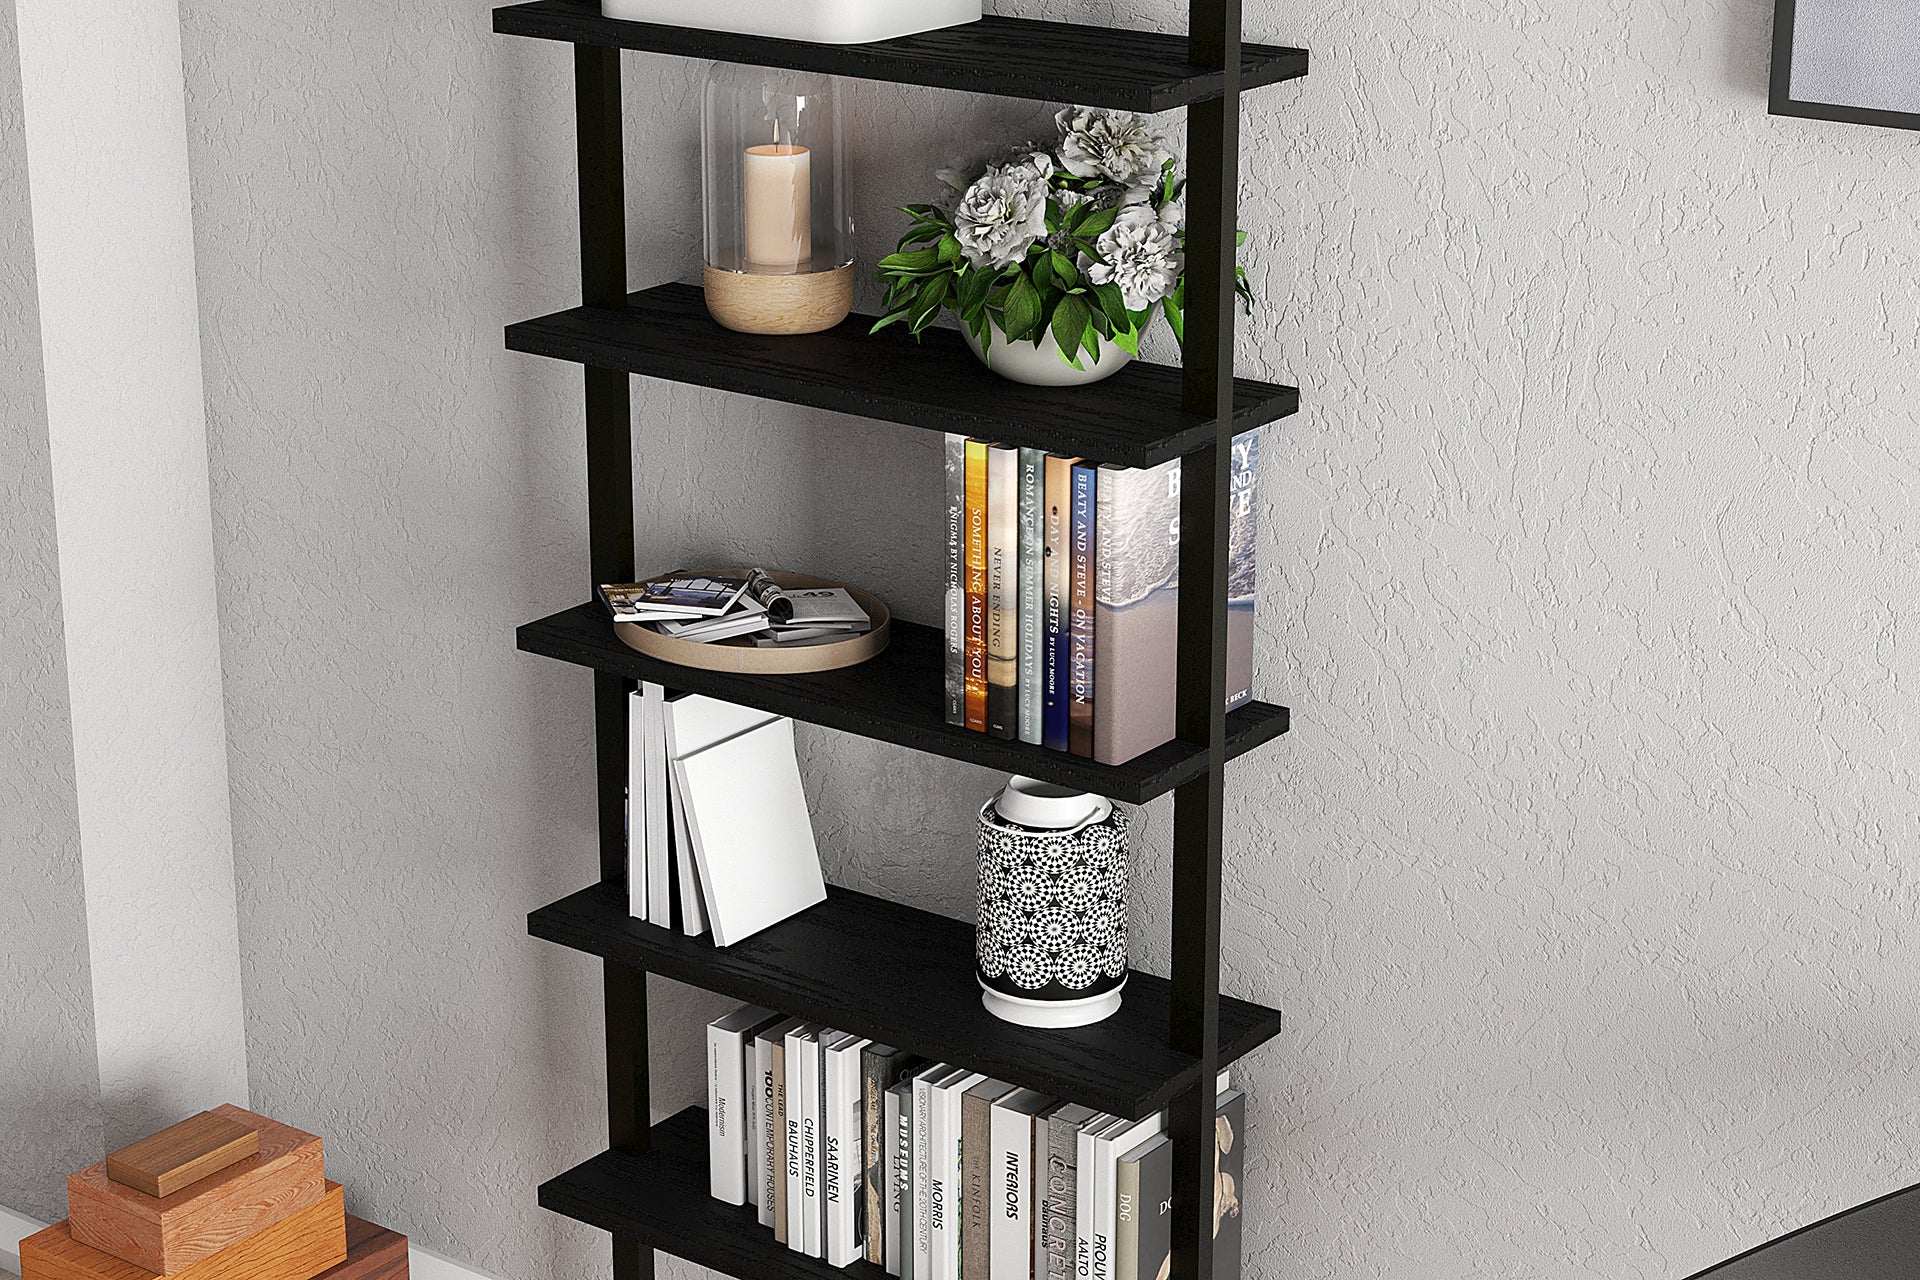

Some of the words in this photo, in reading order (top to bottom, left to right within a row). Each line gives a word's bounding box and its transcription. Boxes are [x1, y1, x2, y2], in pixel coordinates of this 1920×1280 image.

[1026, 464, 1034, 536] ROMANCE
[1078, 474, 1087, 518] BEATY
[1026, 536, 1034, 556] ON
[1050, 515, 1059, 544] DAY
[1077, 521, 1086, 551] AND
[1102, 526, 1112, 558] AND
[950, 549, 958, 558] BY
[972, 508, 982, 593] SOMETHING
[992, 547, 1002, 590] NEVER
[1050, 548, 1060, 578] AND
[1025, 558, 1034, 610] SUMMER
[1076, 555, 1086, 597] STEVE
[1102, 562, 1112, 603] STEVE
[972, 596, 982, 646] ABOUT
[992, 595, 1002, 648] ENDING
[1050, 582, 1059, 634] NIGHTS
[1076, 609, 1086, 629] ON
[1024, 614, 1034, 676] HOLIDAYS
[1049, 636, 1056, 646] BY
[972, 648, 982, 679] YOU
[1024, 676, 1032, 688] BY
[1076, 635, 1086, 704] VACATION
[1230, 689, 1248, 703] BECK
[918, 1088, 927, 1120] VISIONARY
[788, 1120, 798, 1178] BAUHAUS
[804, 1118, 814, 1198] CHIPPERFIELD
[899, 1114, 909, 1191] MUSEUMS
[918, 1120, 928, 1171] ARCHITECTURE
[827, 1136, 839, 1204] SAARINEN
[893, 1156, 901, 1213] LIVING
[919, 1172, 928, 1182] OF
[919, 1183, 928, 1198] THE
[1006, 1150, 1018, 1220] INTERIORS
[766, 1174, 775, 1212] HOUSES
[919, 1198, 928, 1218] 20TH
[932, 1179, 943, 1230] MORRIS
[972, 1174, 980, 1229] KINFOLK
[1120, 1192, 1132, 1222] DOG
[919, 1218, 928, 1254] CENTURY
[1078, 1236, 1089, 1277] AALTO
